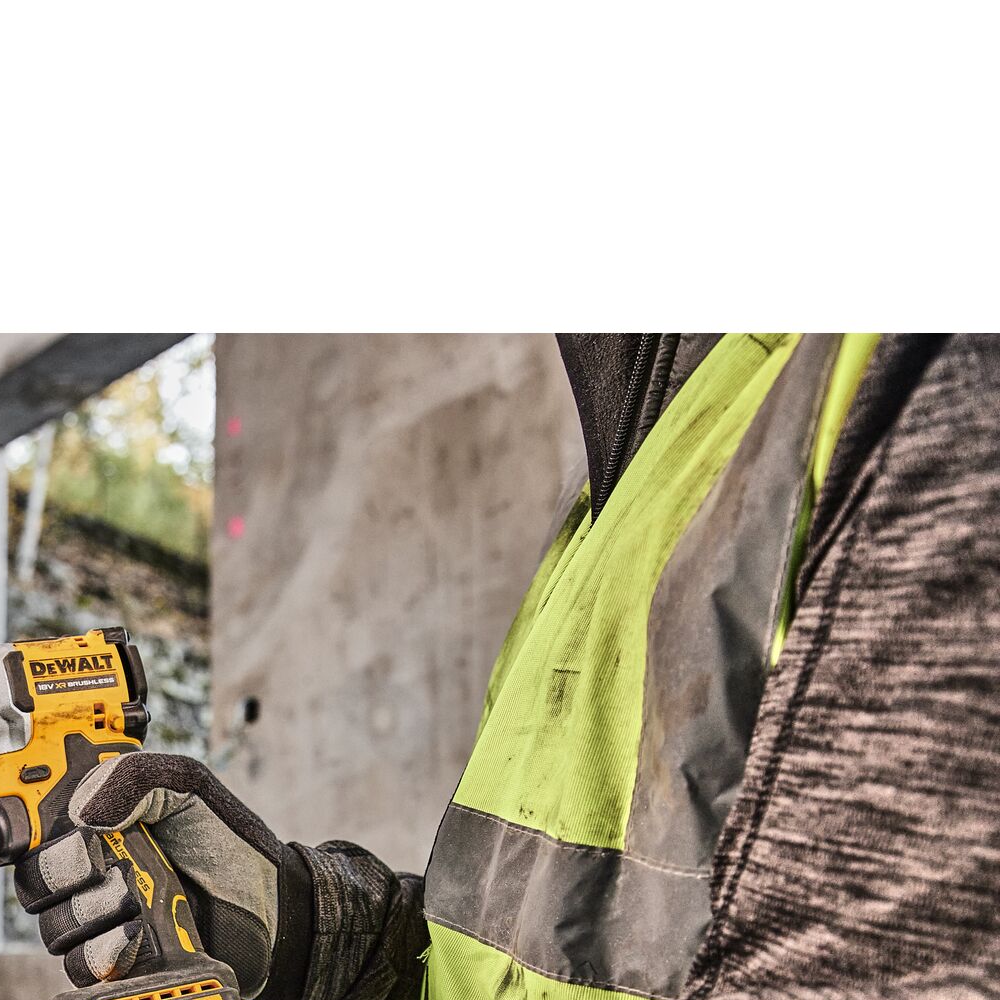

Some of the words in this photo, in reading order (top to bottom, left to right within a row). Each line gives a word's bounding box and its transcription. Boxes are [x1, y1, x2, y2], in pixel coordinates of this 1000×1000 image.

[29, 654, 113, 676] DEWALT
[37, 683, 54, 692] 18V
[67, 677, 115, 688] BRUSHLESS
[106, 833, 151, 892] BRUSESS
